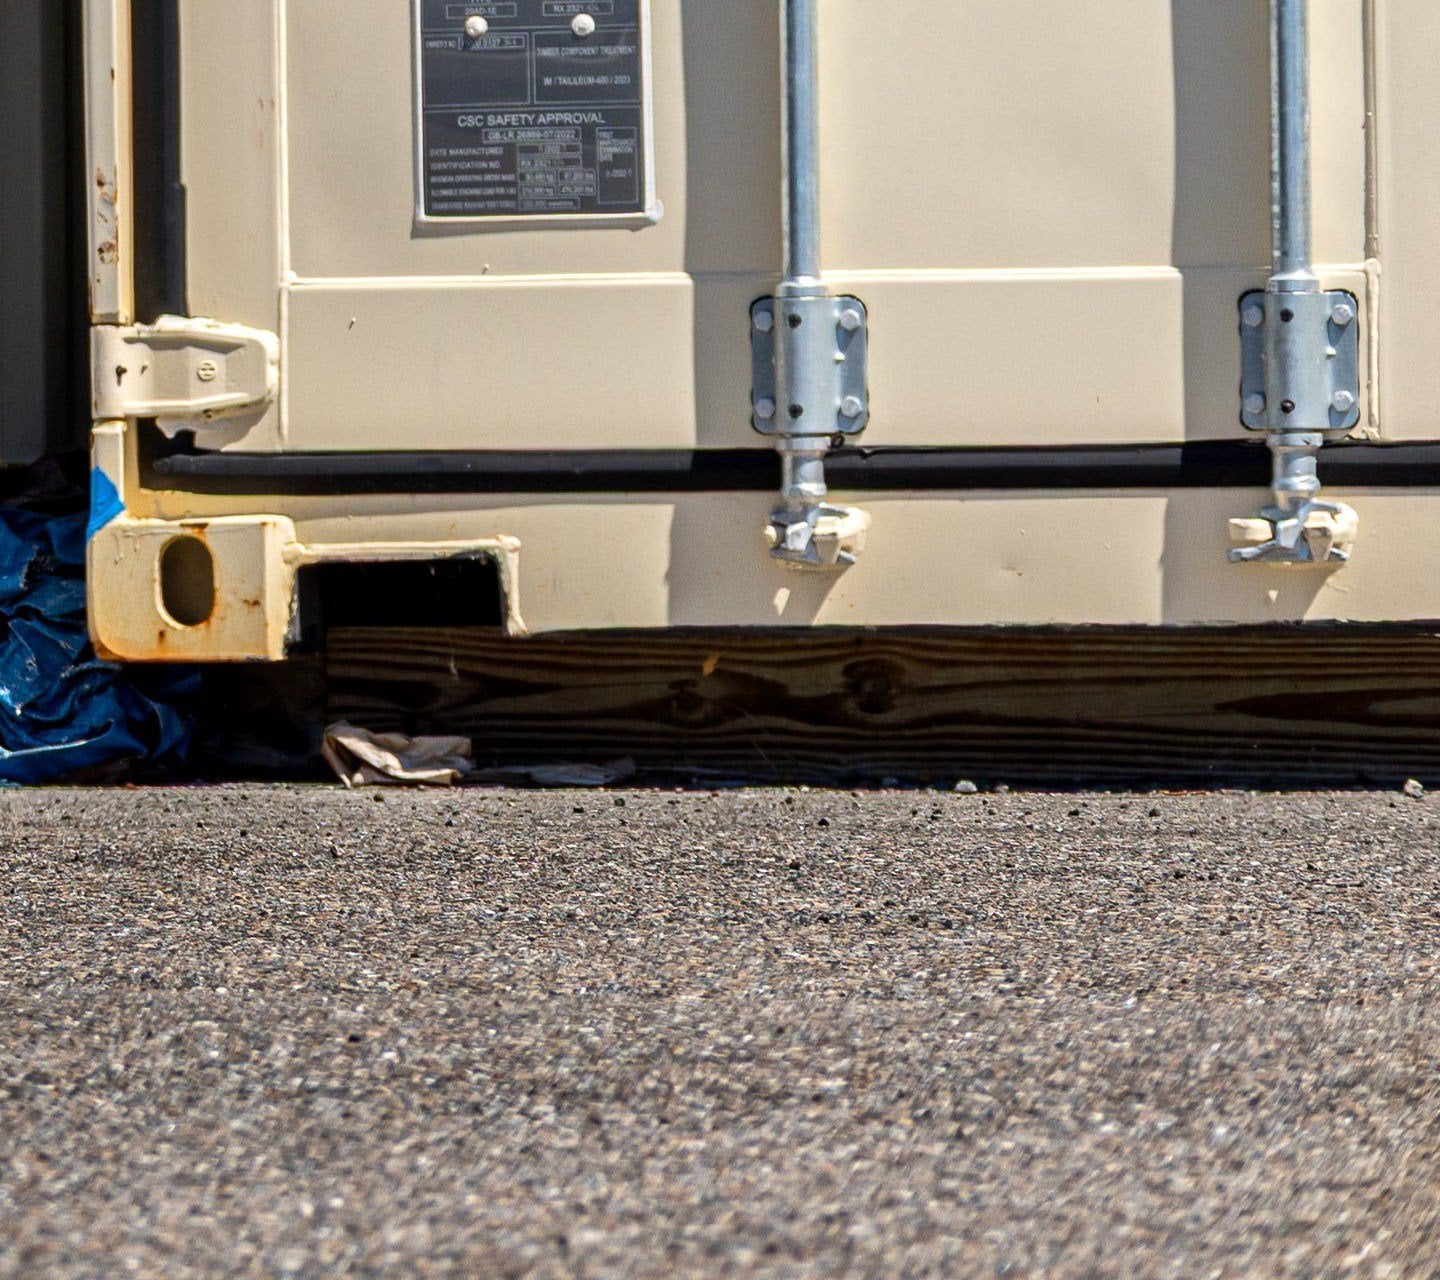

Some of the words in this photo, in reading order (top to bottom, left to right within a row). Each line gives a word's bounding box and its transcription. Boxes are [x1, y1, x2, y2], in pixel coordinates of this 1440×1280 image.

[457, 115, 484, 127] CSC
[487, 113, 535, 126] SAFETY
[537, 112, 606, 125] APPROVAL
